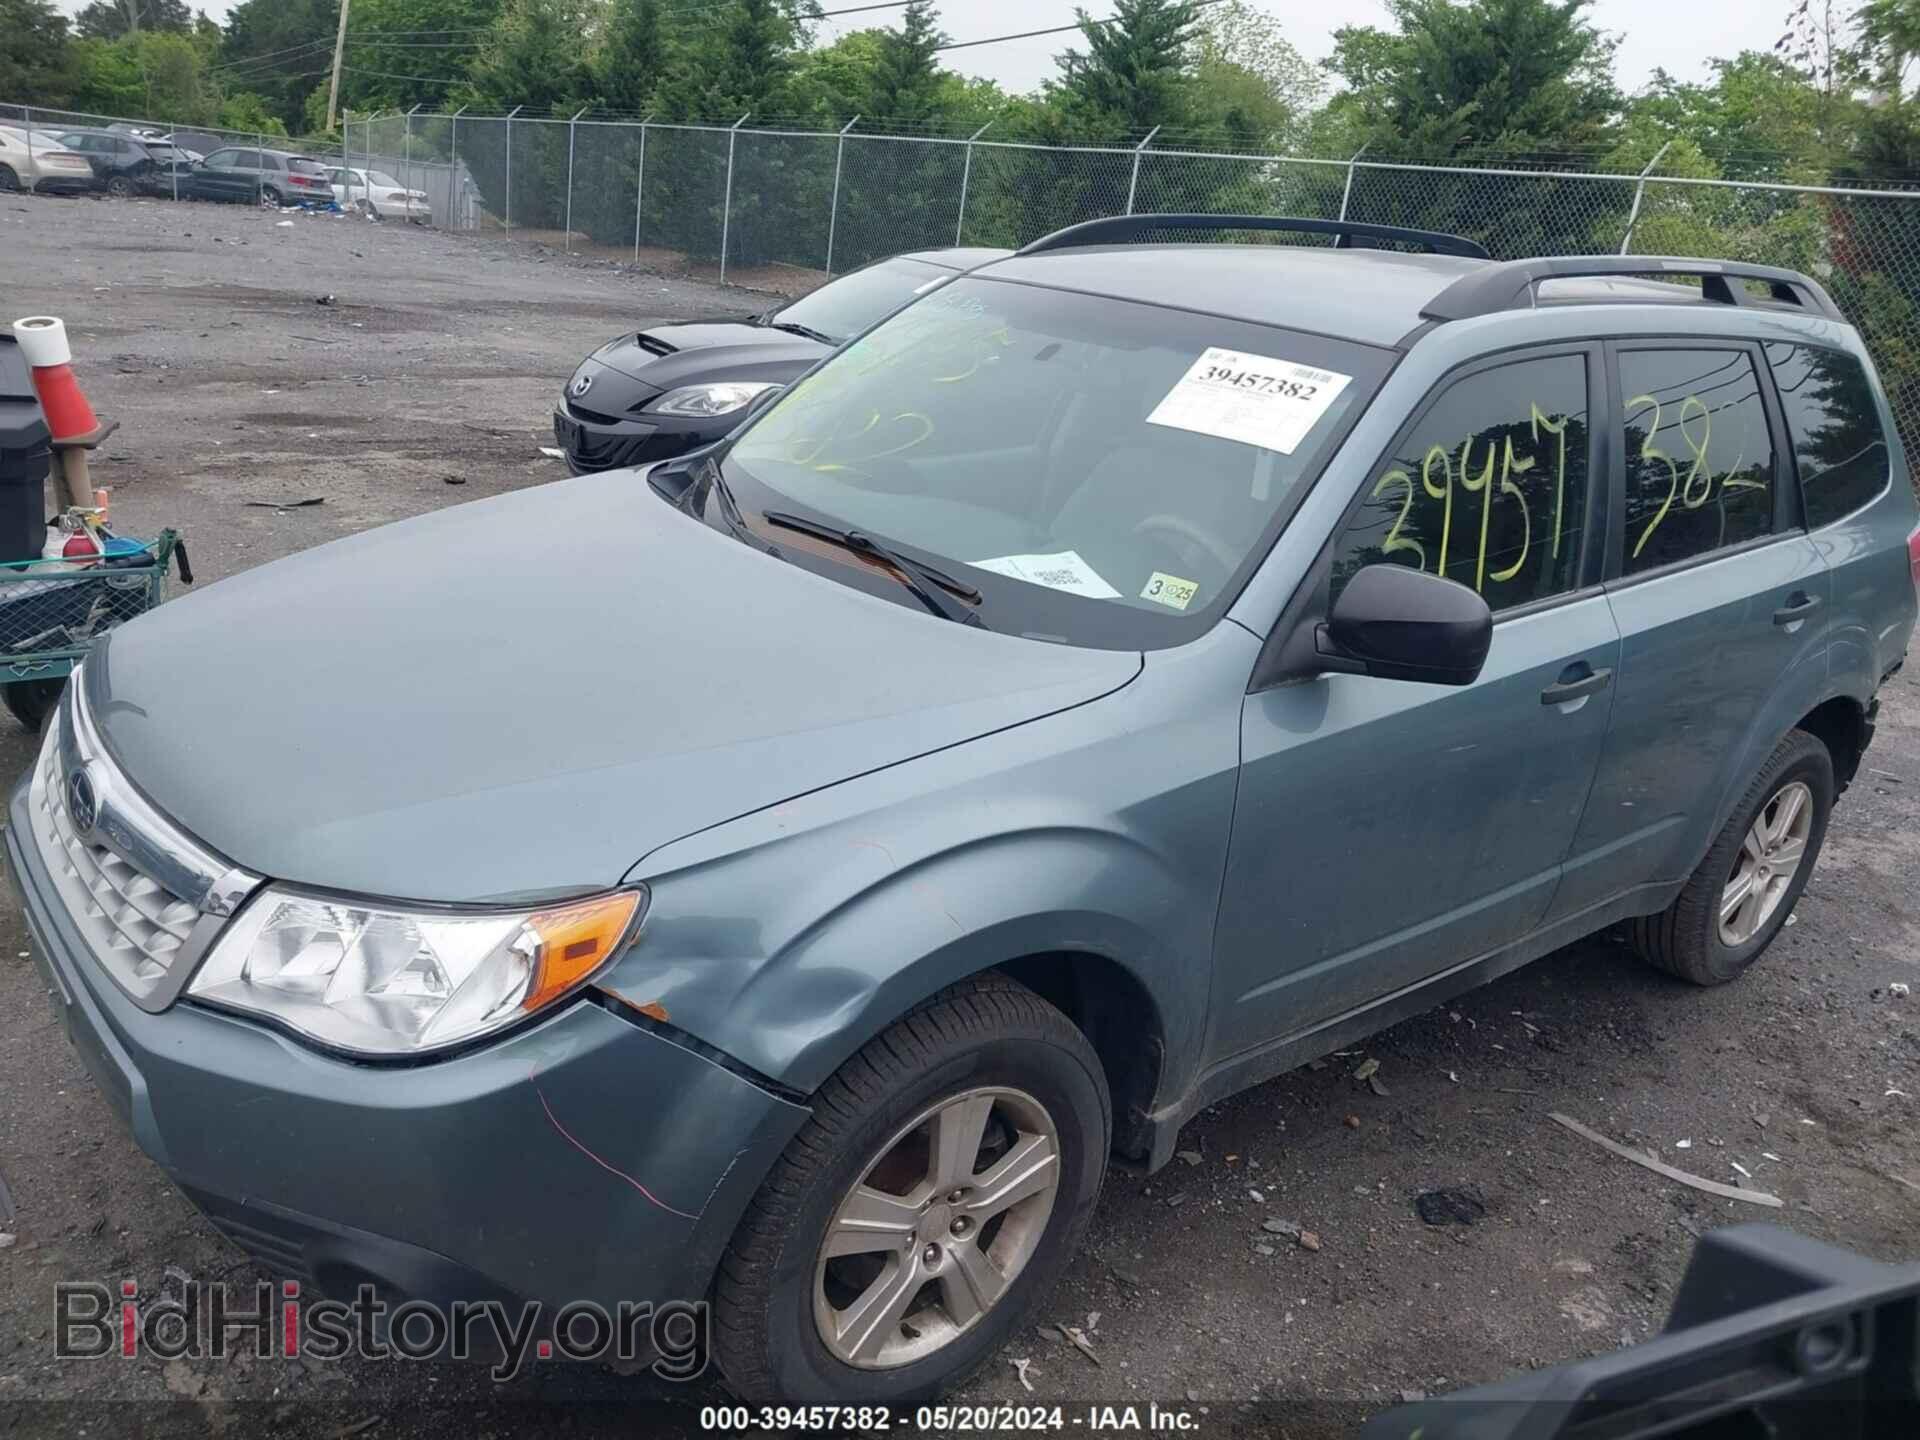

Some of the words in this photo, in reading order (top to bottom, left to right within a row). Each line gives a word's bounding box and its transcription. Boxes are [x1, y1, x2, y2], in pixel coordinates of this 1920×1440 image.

[1199, 366, 1317, 401] 39457382
[1150, 580, 1164, 595] 3
[1175, 586, 1193, 601] 25
